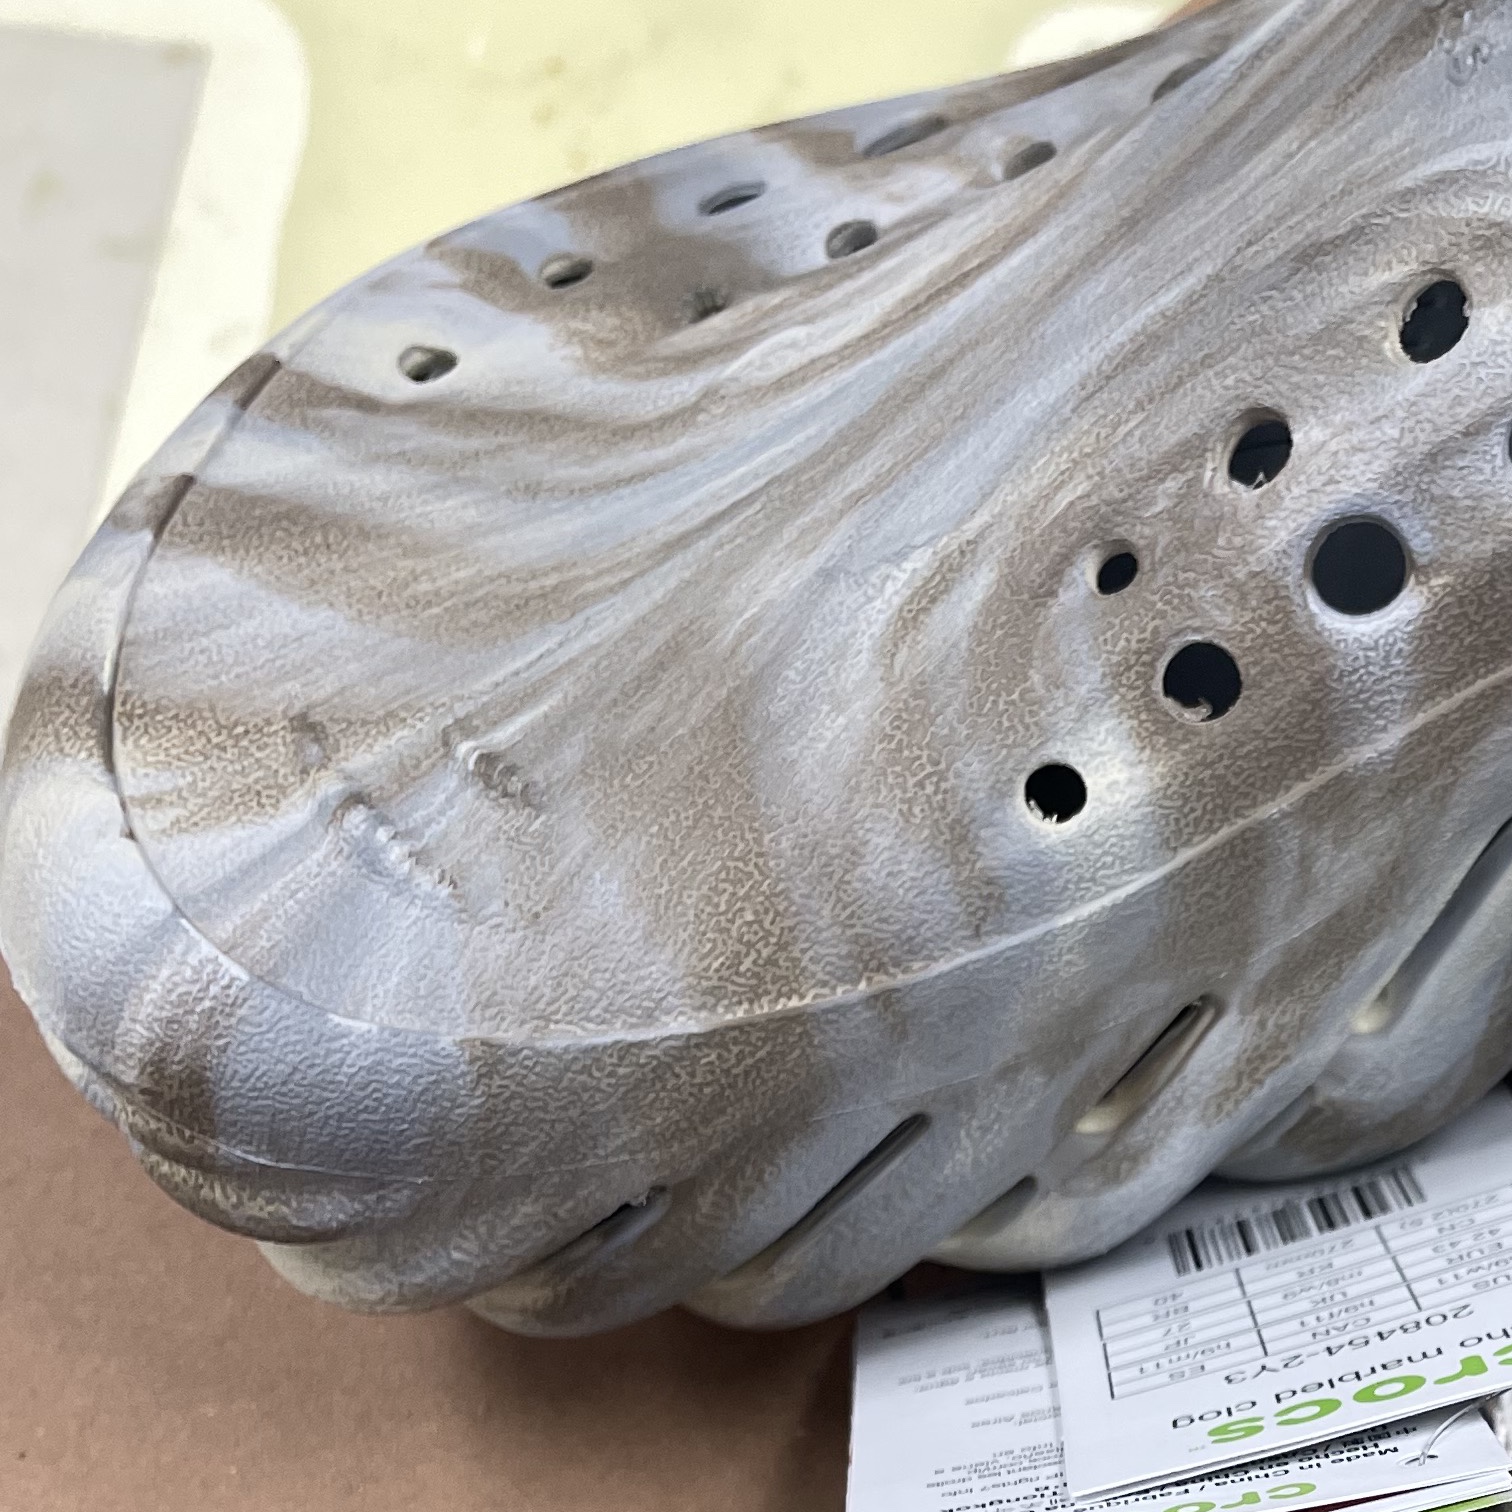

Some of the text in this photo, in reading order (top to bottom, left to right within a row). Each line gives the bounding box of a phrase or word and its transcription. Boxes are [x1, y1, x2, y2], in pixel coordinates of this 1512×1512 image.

[1472, 1274, 1512, 1291] US
[1312, 1317, 1371, 1339] CAN
[1225, 1304, 1475, 1385] 208454-2Y3
[1274, 1347, 1443, 1404] marbled
[1172, 1401, 1257, 1429] clog
[1331, 1446, 1399, 1464] Made
[1299, 1462, 1322, 1471] in
[1214, 1469, 1290, 1486] China
